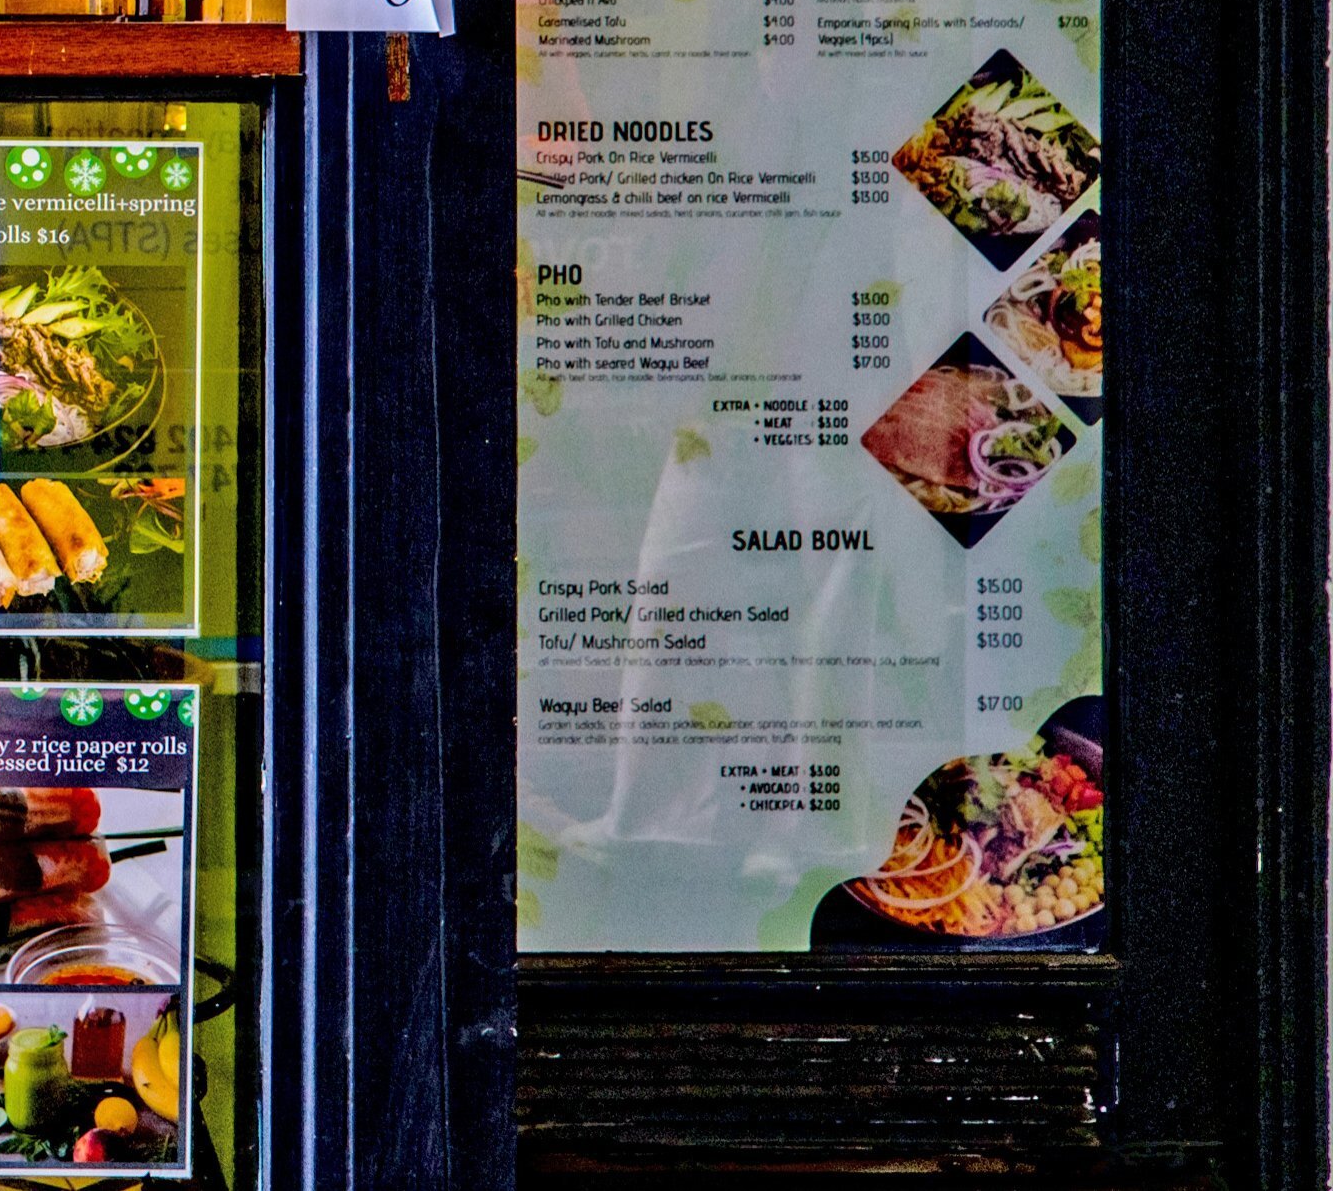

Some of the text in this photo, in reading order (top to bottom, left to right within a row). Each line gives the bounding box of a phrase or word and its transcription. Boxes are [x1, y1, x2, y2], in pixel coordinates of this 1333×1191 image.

[538, 120, 714, 143] DRIED NOODLES
[11, 192, 196, 216] vermicelli+spring
[37, 227, 70, 245] $16
[538, 263, 582, 286] PHO
[732, 529, 874, 552] SALAD BOWL
[539, 580, 668, 597] Crispy Pork Salad
[15, 739, 26, 753] 2
[31, 735, 71, 754] rice
[77, 741, 137, 759] paper
[141, 737, 187, 755] rolls
[55, 753, 105, 775] juice
[117, 757, 149, 773] $12
